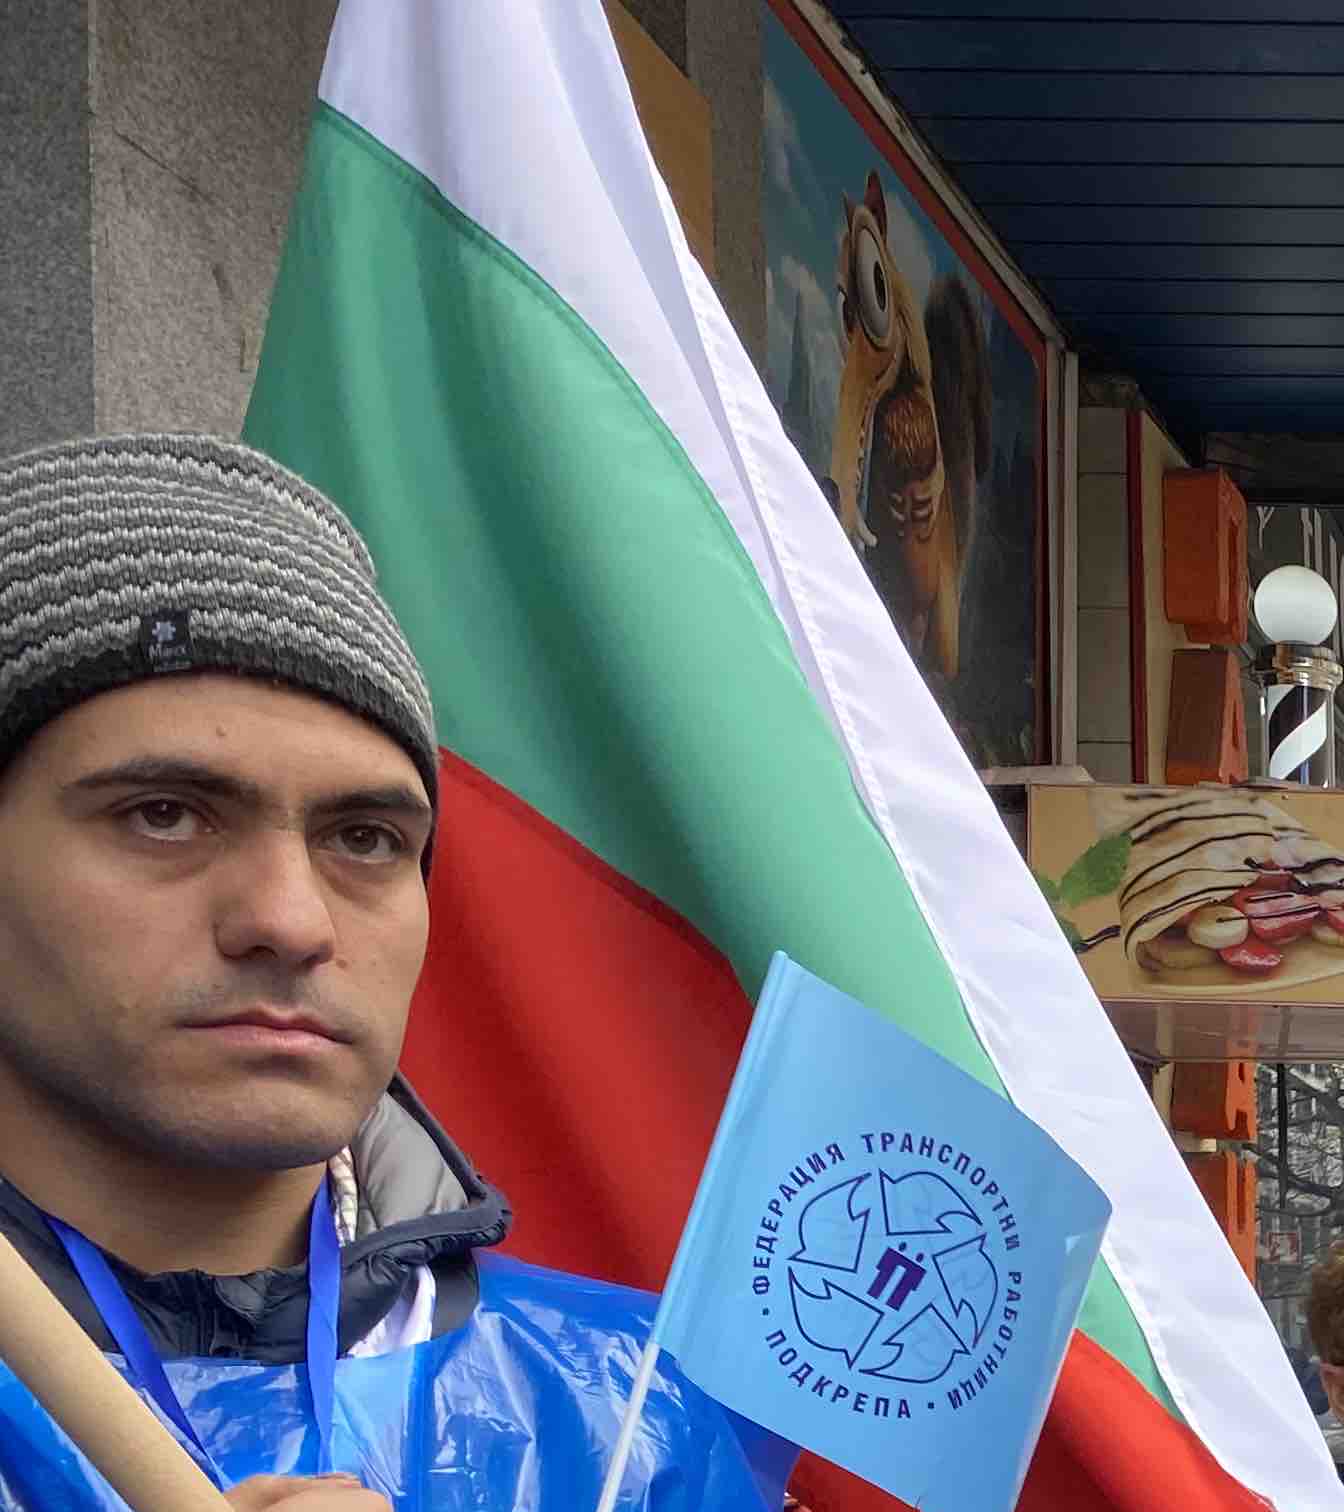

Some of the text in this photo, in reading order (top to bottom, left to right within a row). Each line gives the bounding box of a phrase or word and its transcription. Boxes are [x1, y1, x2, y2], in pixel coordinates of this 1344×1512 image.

[752, 1131, 1023, 1411] ФЕДЕРАЦИЯ ТРАНСПОРТНИ РАБОТНИЦИ
[765, 1329, 912, 1419] ПОДКРЕПА
